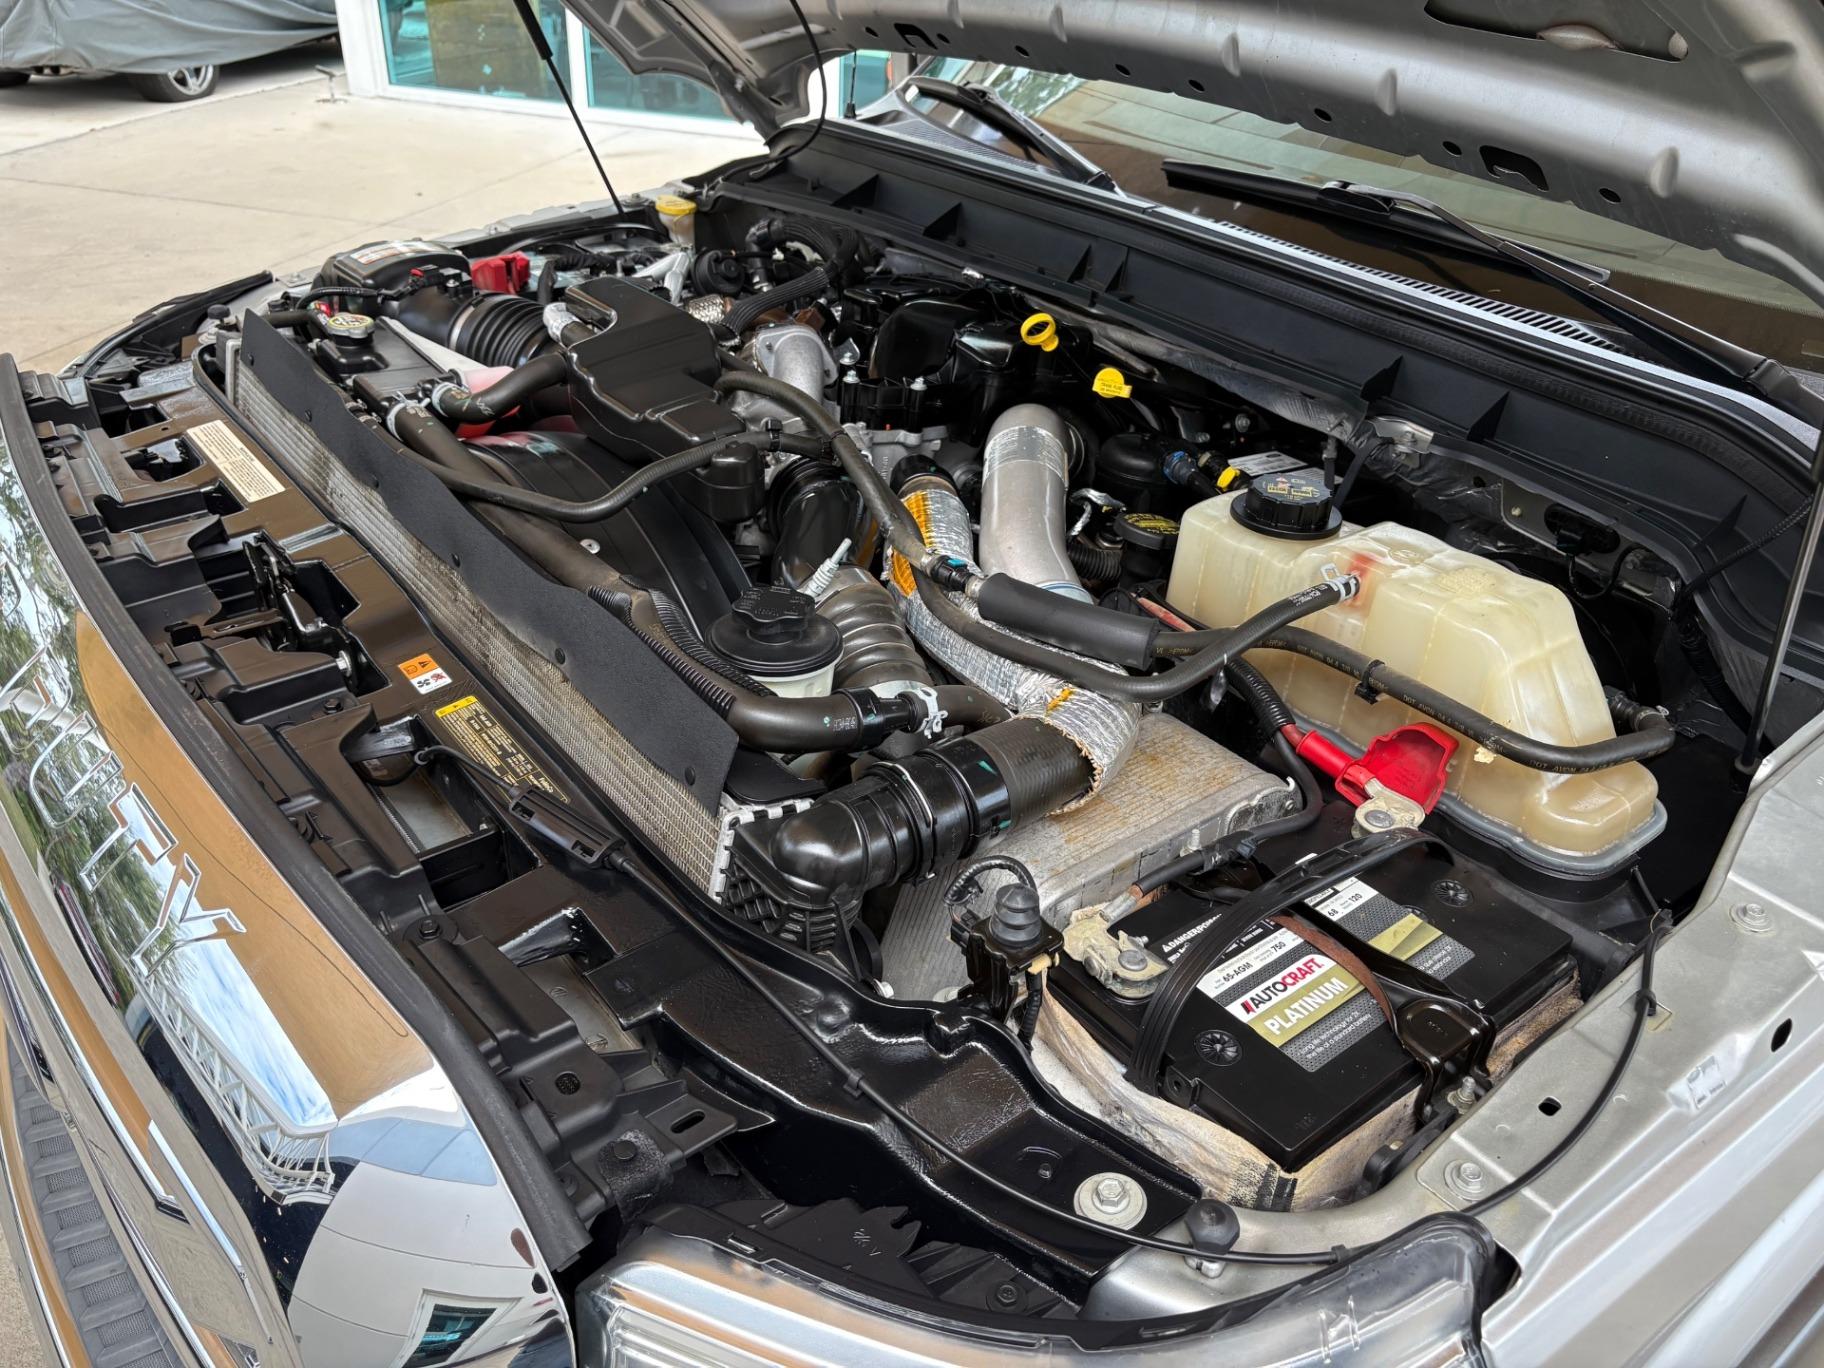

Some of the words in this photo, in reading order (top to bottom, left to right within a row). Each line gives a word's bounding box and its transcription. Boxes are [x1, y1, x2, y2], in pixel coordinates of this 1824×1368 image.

[1327, 907, 1339, 918] 68
[1350, 893, 1363, 903] 120
[1222, 962, 1254, 983] 65-AGM
[1271, 941, 1287, 953] 750
[1251, 957, 1322, 1009] AUTOCRAFT
[1263, 976, 1349, 1035] PLATINUM
